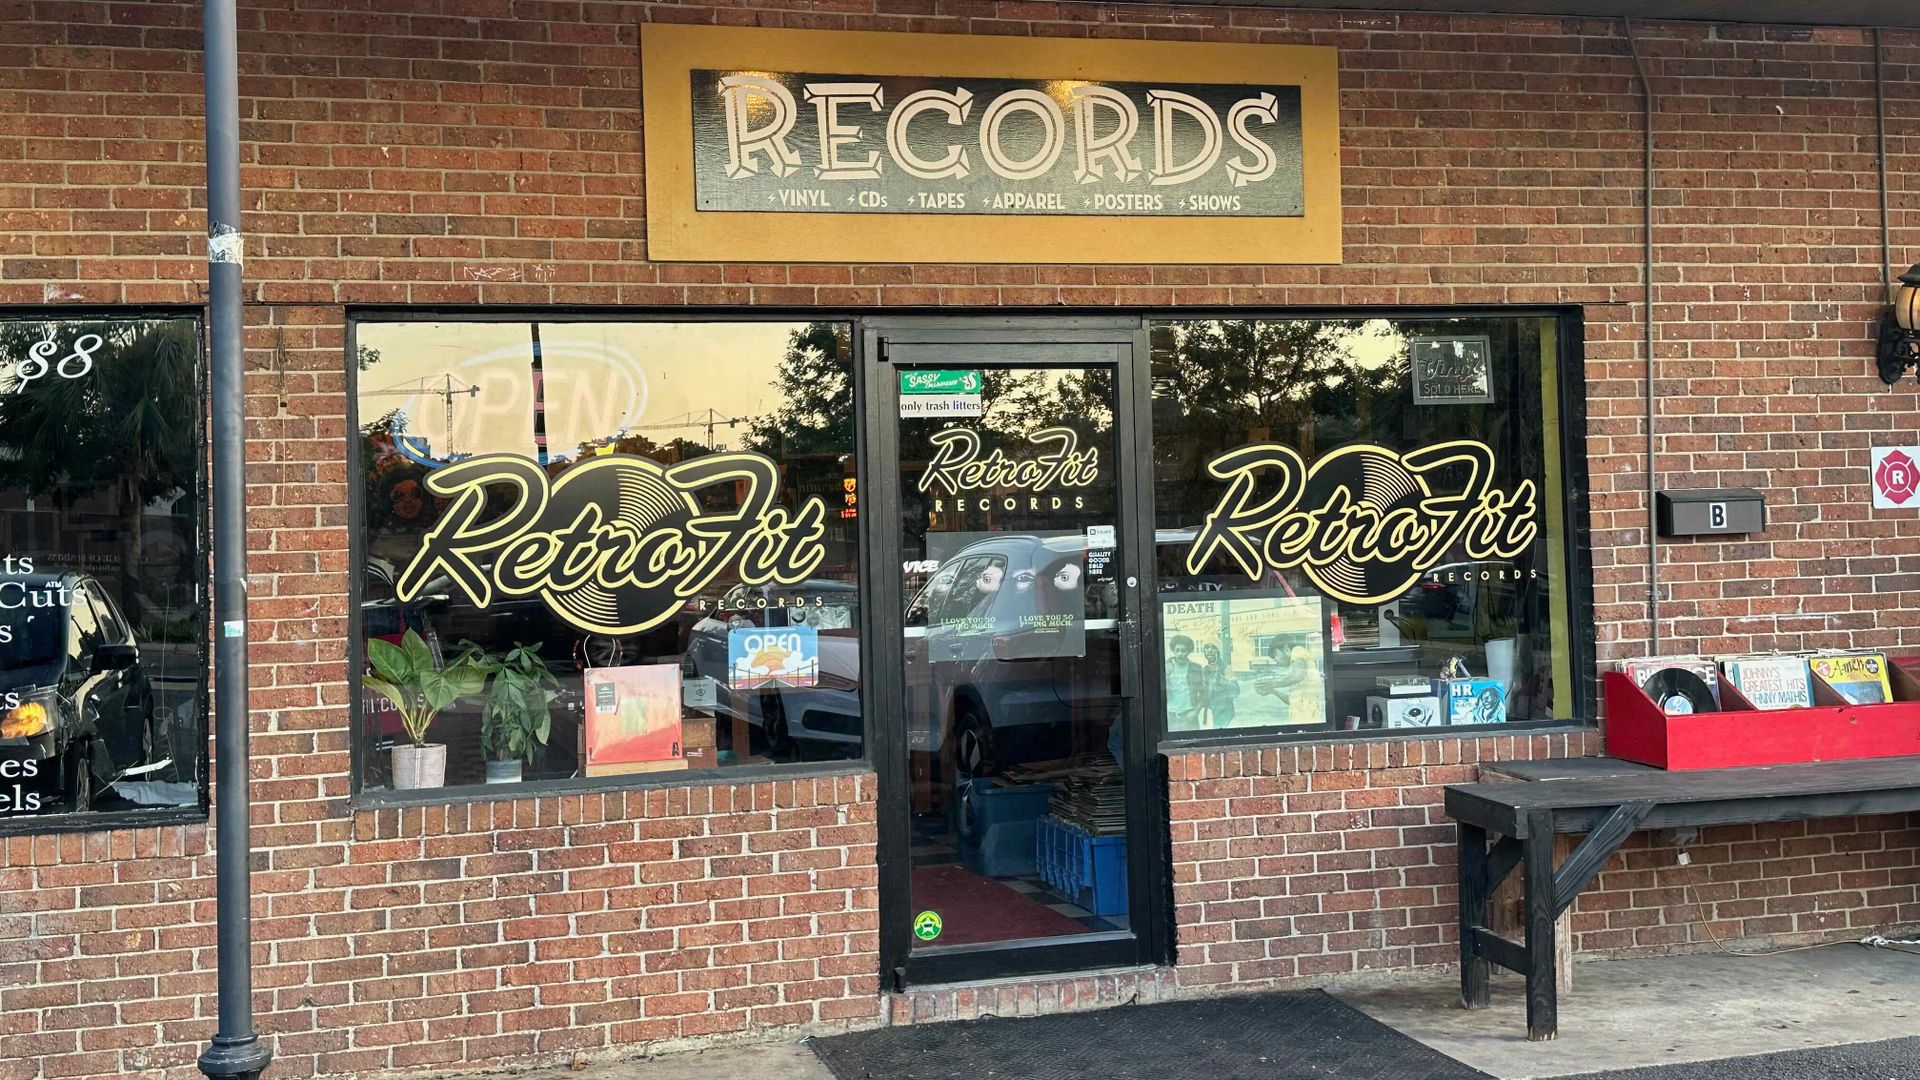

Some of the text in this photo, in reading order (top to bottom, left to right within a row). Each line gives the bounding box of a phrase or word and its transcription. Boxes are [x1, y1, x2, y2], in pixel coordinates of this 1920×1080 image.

[718, 75, 1278, 187] RECORDS
[778, 189, 1241, 211] VINYL CDs TAPES APPAREL POSTERS SHOWS
[1424, 383, 1451, 395] SOLD
[417, 367, 620, 449] OPEN
[901, 400, 981, 413] only trash litters
[1892, 469, 1905, 485] R
[935, 496, 1084, 512] RECORDS
[1712, 504, 1725, 527] B
[1433, 569, 1537, 583] RECORDS
[0, 581, 87, 609] Cuts
[700, 596, 823, 611] RECORDS
[1166, 602, 1215, 615] DEATH
[1023, 614, 1044, 622] LOVE
[744, 633, 801, 653] OPEN
[1451, 684, 1473, 697] HR
[1743, 678, 1806, 693] GREATEST HITS
[1777, 690, 1808, 703] MATHIS
